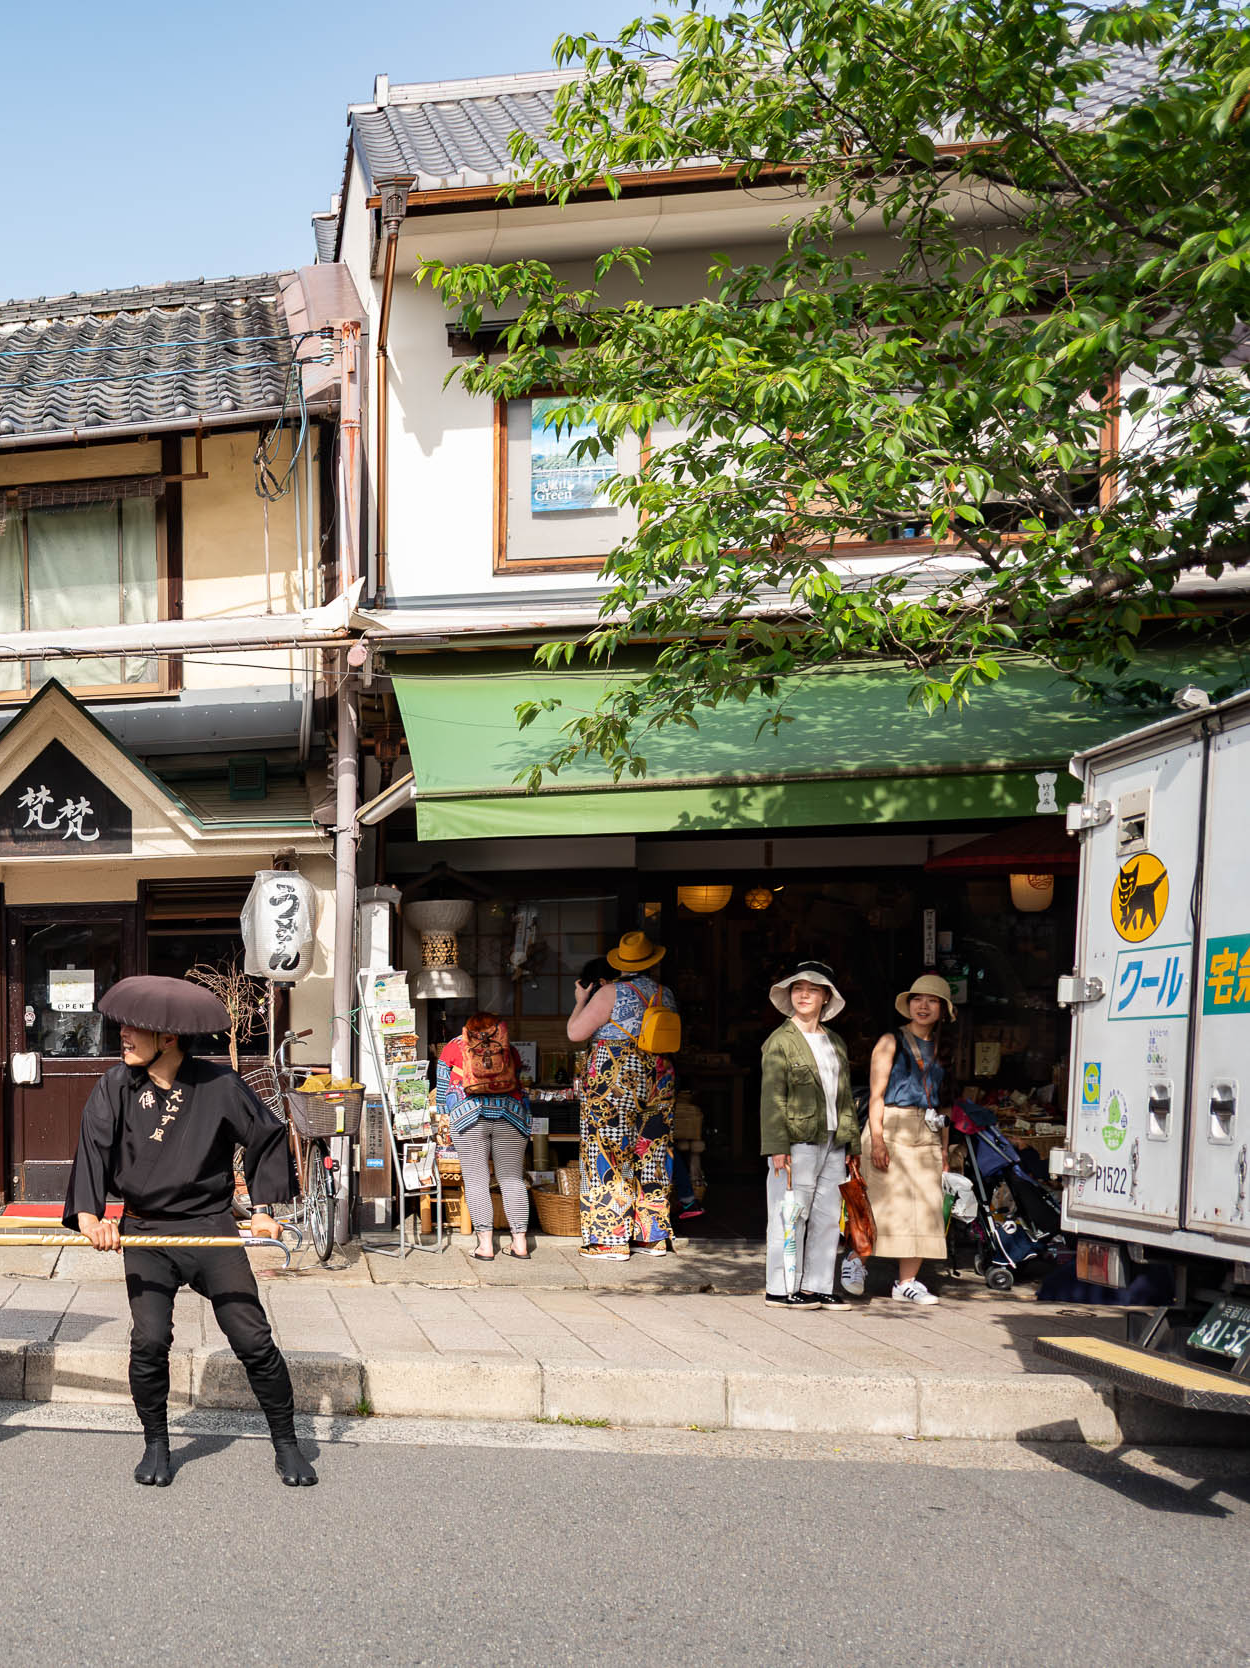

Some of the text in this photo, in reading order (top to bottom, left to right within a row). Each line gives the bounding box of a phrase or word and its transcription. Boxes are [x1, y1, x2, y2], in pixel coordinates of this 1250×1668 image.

[534, 491, 572, 501] Green
[17, 784, 100, 842] 梵梵
[269, 883, 301, 971] うどん
[1117, 956, 1184, 1012] クール
[149, 1088, 184, 1142] えびす屋
[1095, 1165, 1128, 1195] P1522
